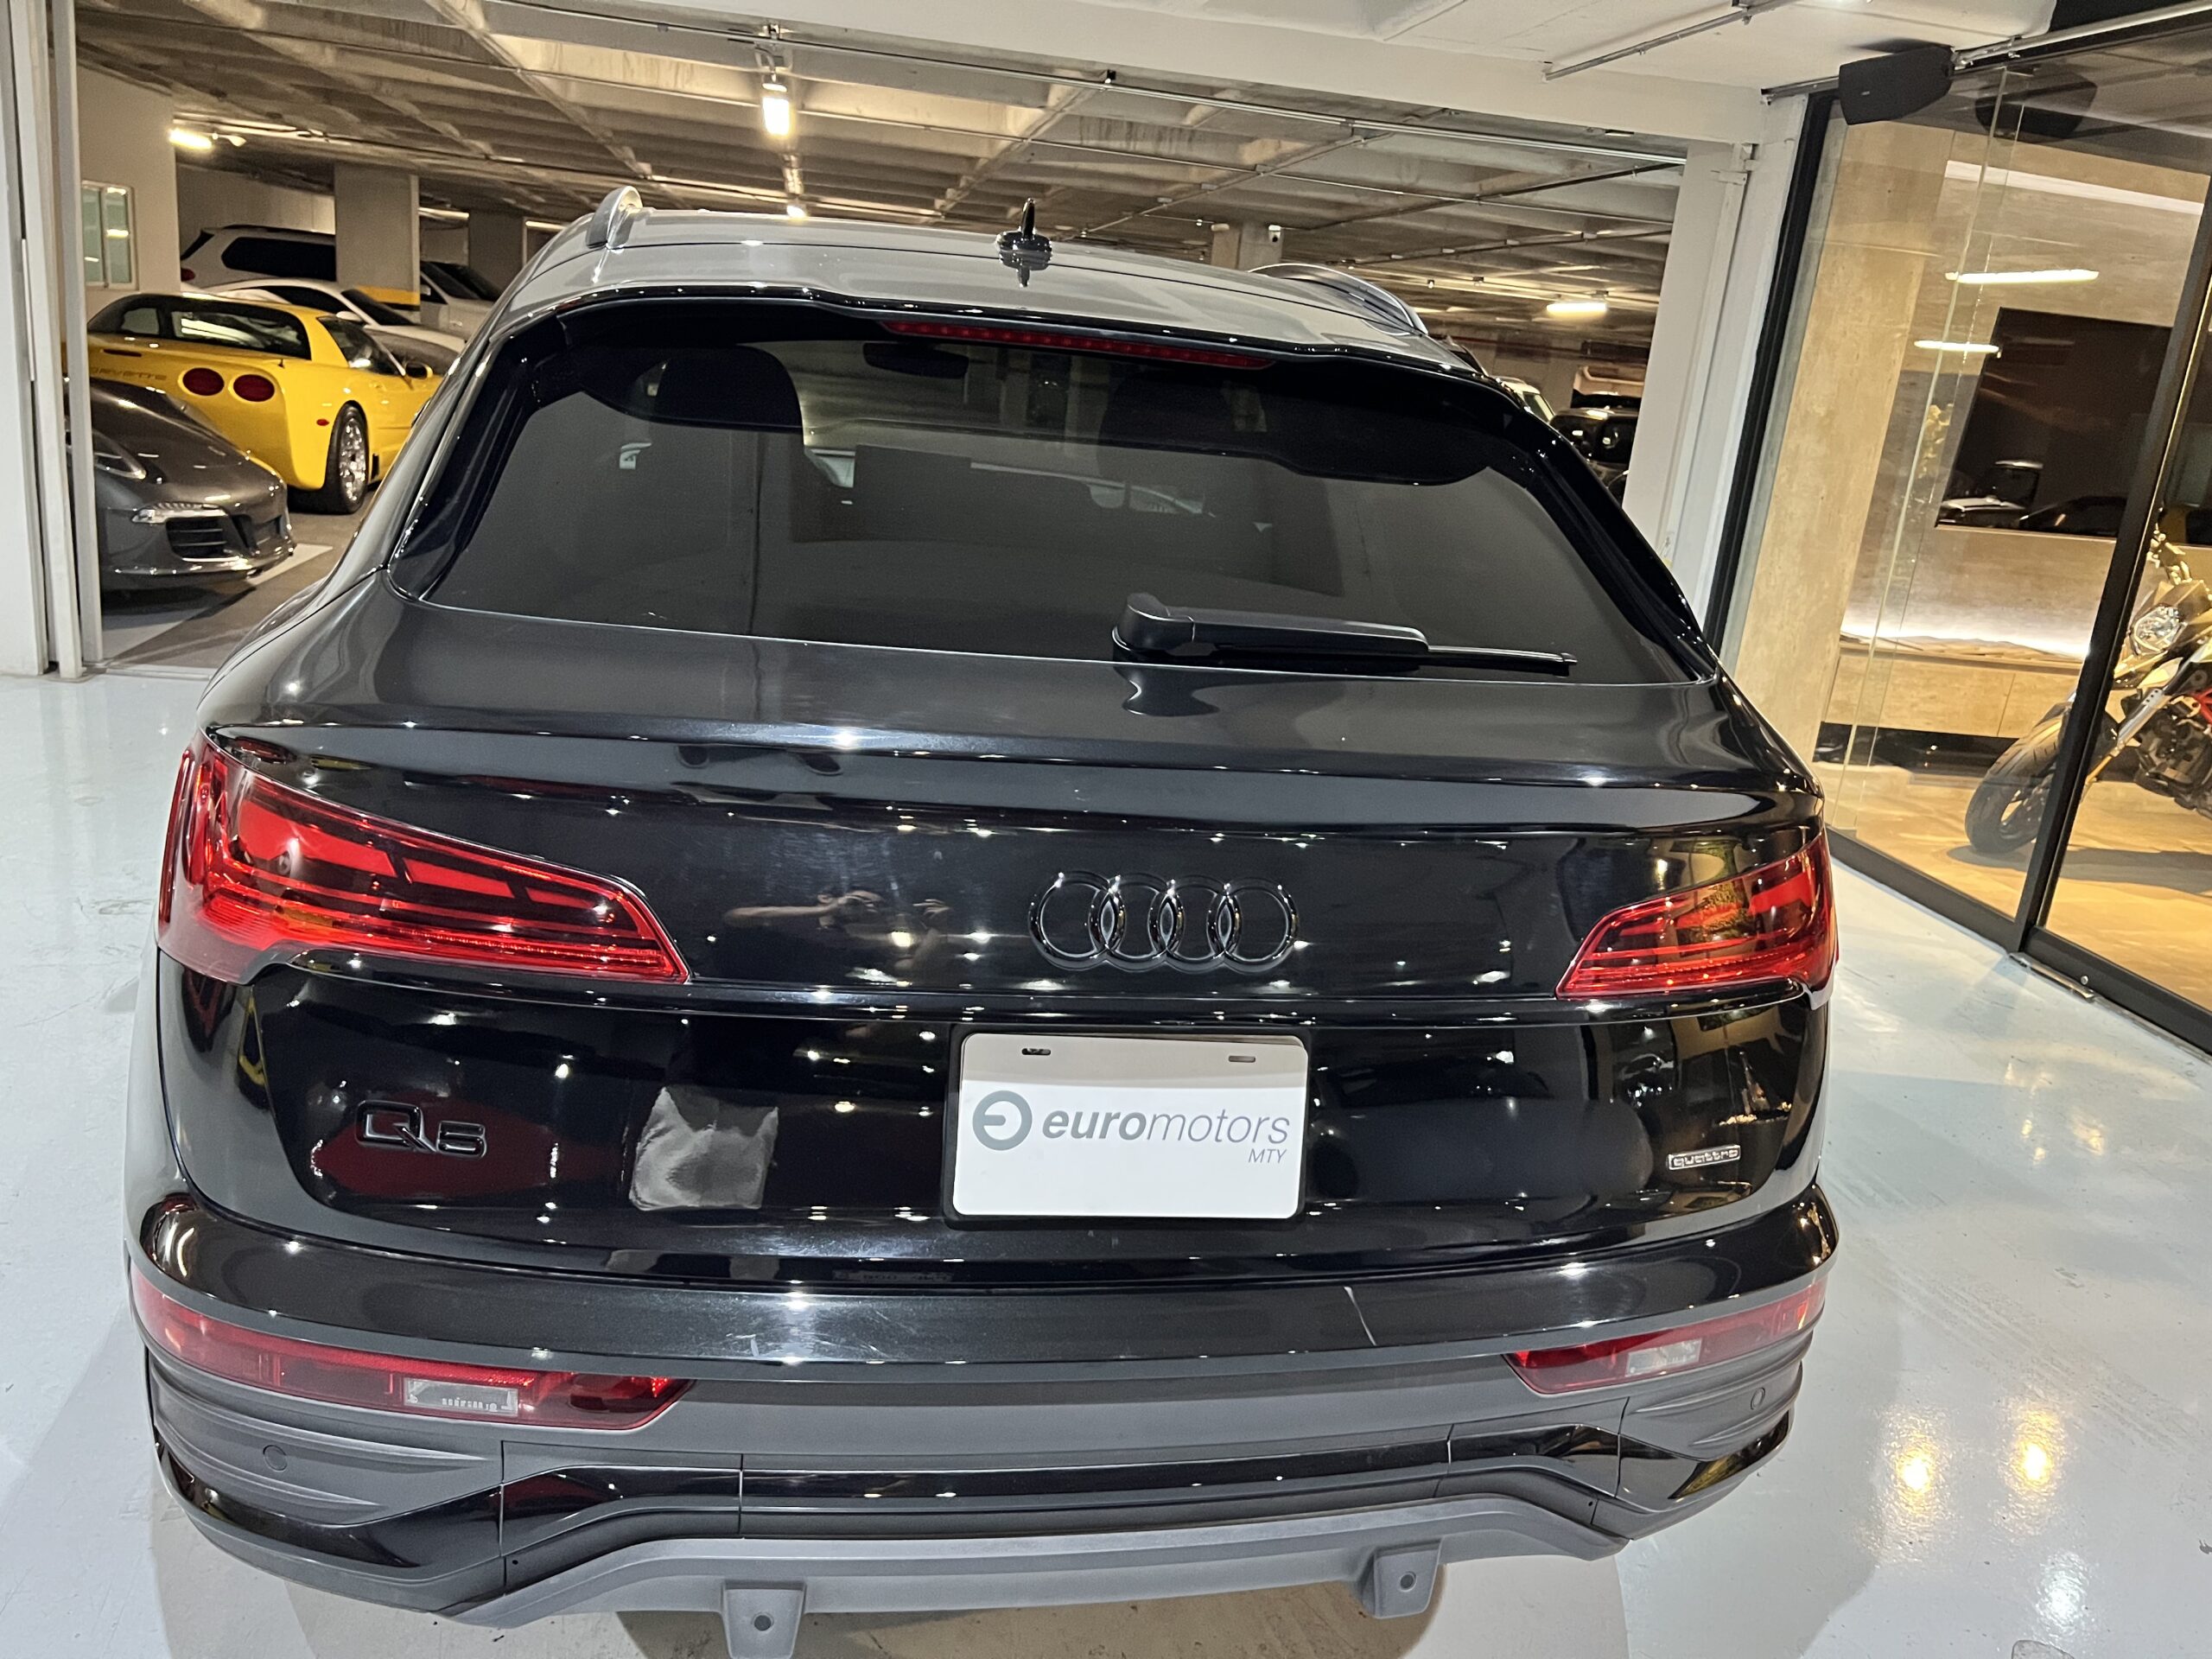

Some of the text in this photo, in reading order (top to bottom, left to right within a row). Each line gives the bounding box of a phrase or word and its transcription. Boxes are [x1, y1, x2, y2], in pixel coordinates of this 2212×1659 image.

[354, 1100, 487, 1159] Q5
[1041, 1109, 1290, 1144] euromotors
[1248, 1148, 1287, 1164] MTY
[1672, 1149, 1738, 1168] quattro
